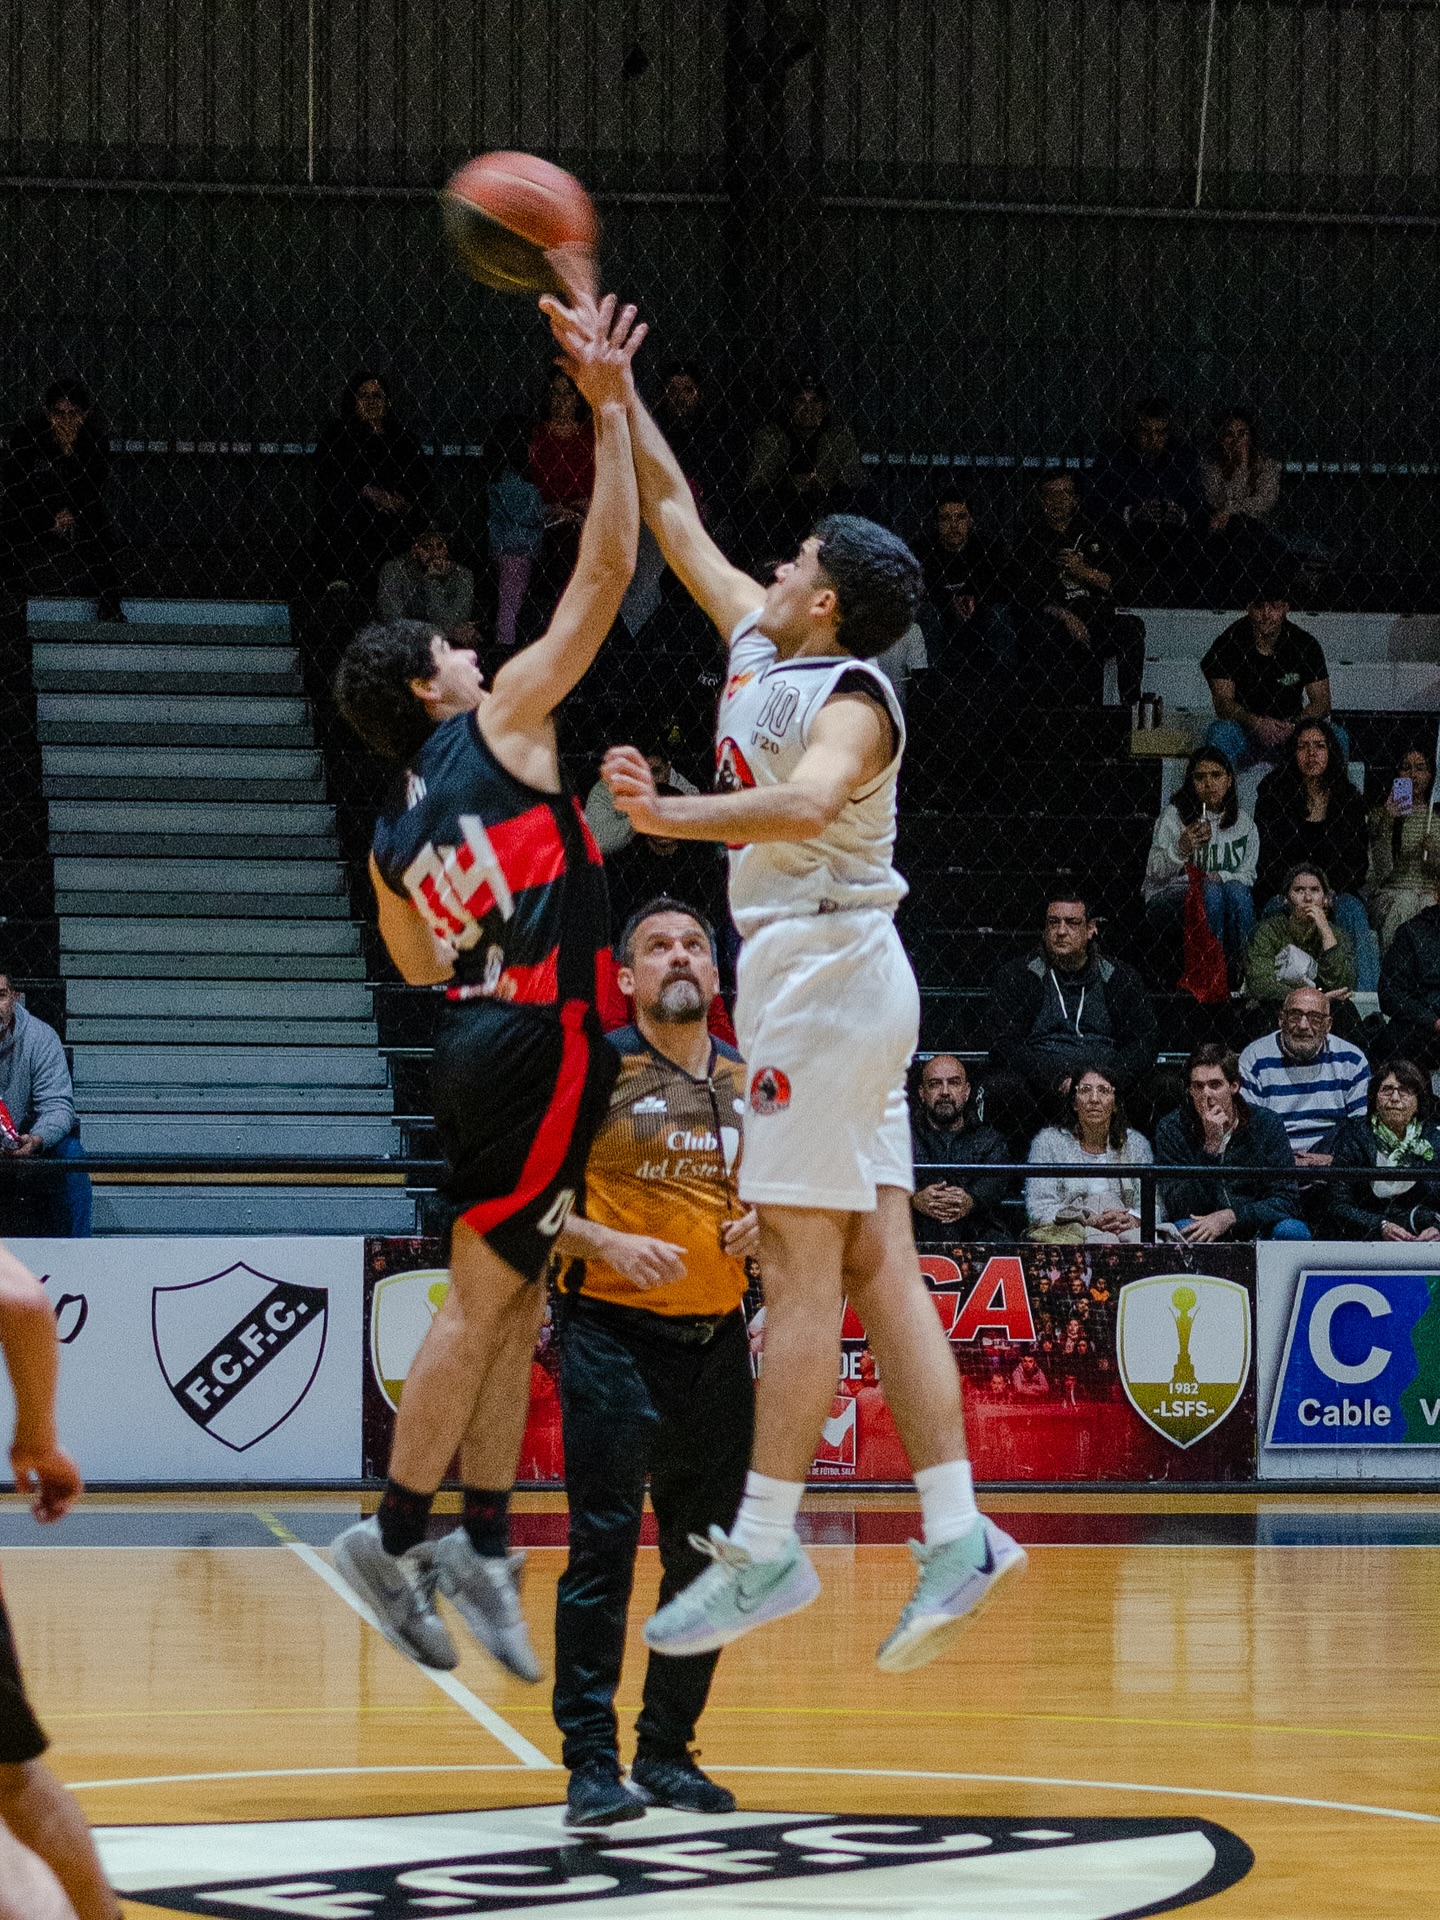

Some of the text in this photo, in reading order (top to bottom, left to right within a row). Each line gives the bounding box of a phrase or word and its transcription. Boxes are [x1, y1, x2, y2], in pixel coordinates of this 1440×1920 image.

[757, 680, 800, 737] 10
[667, 1130, 718, 1150] Club
[636, 1159, 669, 1178] del
[1308, 1283, 1393, 1384] C
[184, 1300, 309, 1411] F.C.F.C.
[1169, 1382, 1199, 1395] 1982
[1297, 1398, 1392, 1427] Cable
[194, 1824, 1075, 1920] F.C.F.C.
